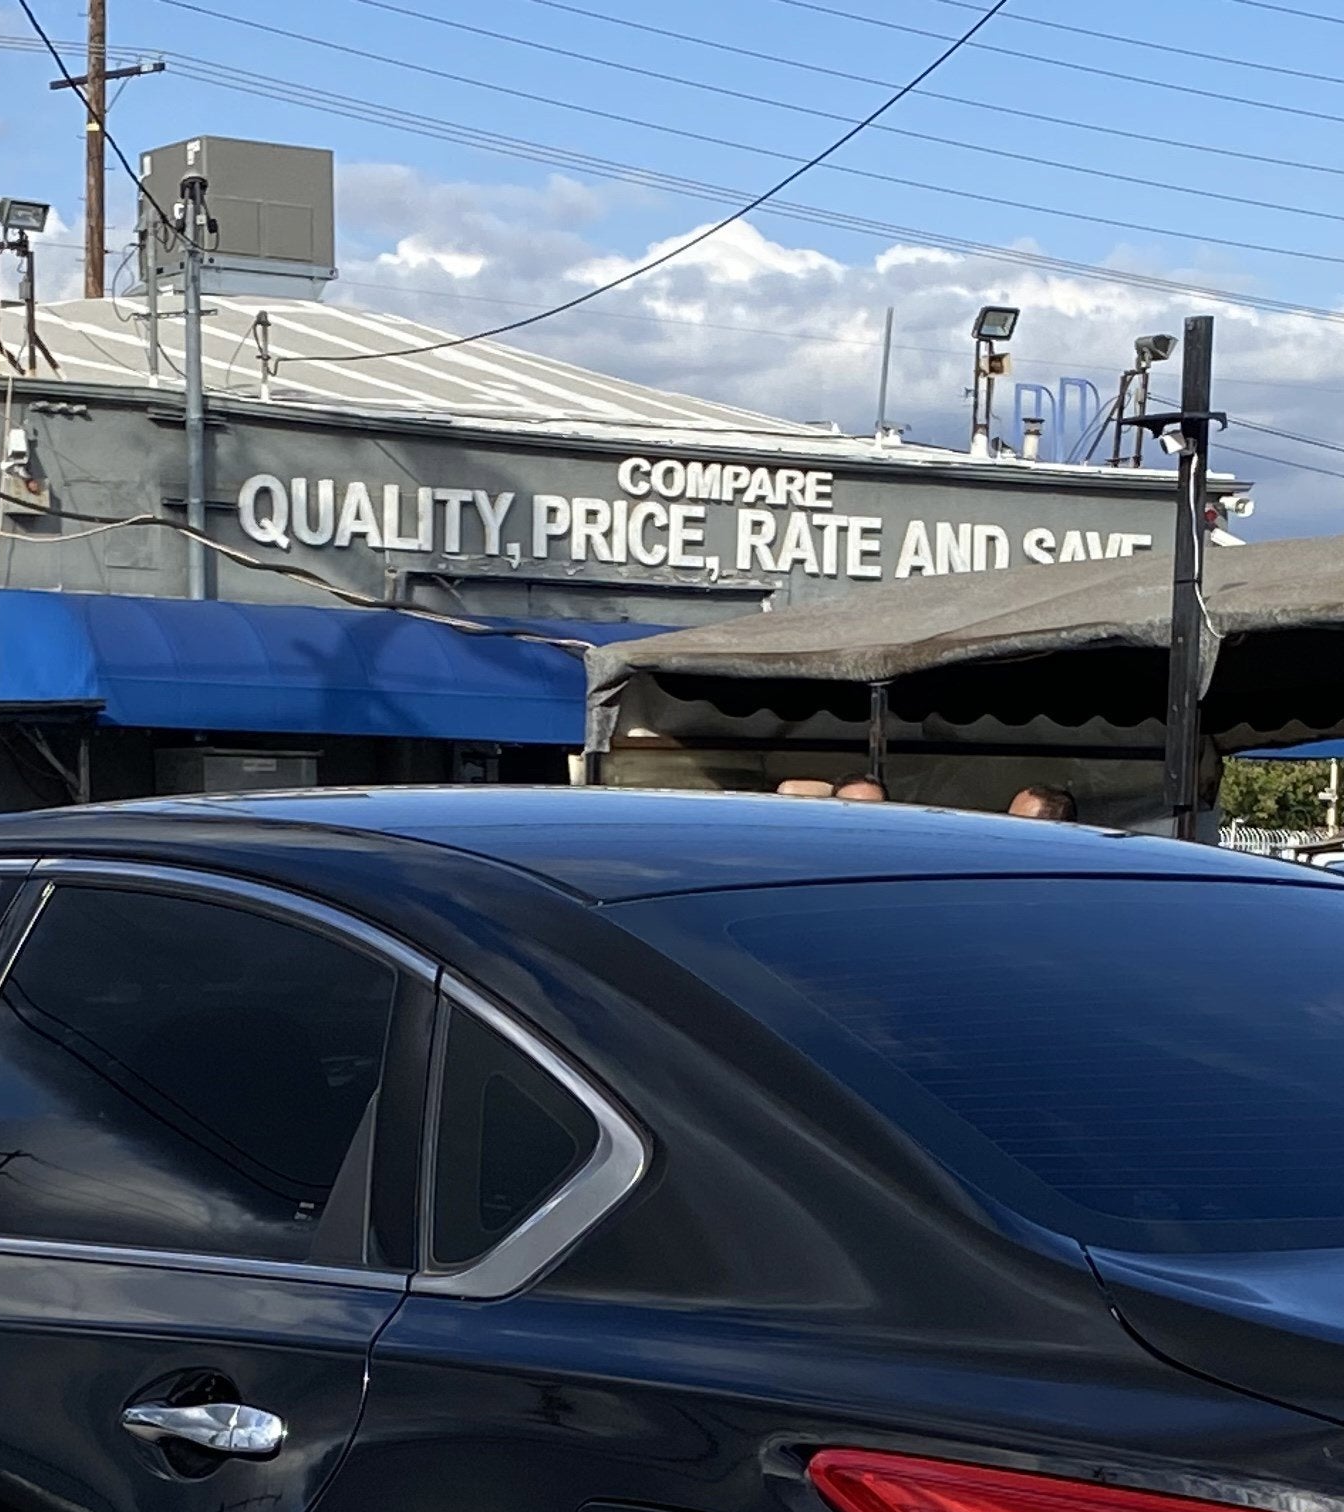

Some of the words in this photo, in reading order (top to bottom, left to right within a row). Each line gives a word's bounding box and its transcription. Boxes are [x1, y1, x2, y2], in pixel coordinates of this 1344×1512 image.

[617, 456, 834, 509] COMPARE
[238, 473, 520, 570] QUALITY,
[532, 494, 720, 582] PRICE,
[737, 508, 883, 579] RATE
[894, 519, 1011, 579] AND
